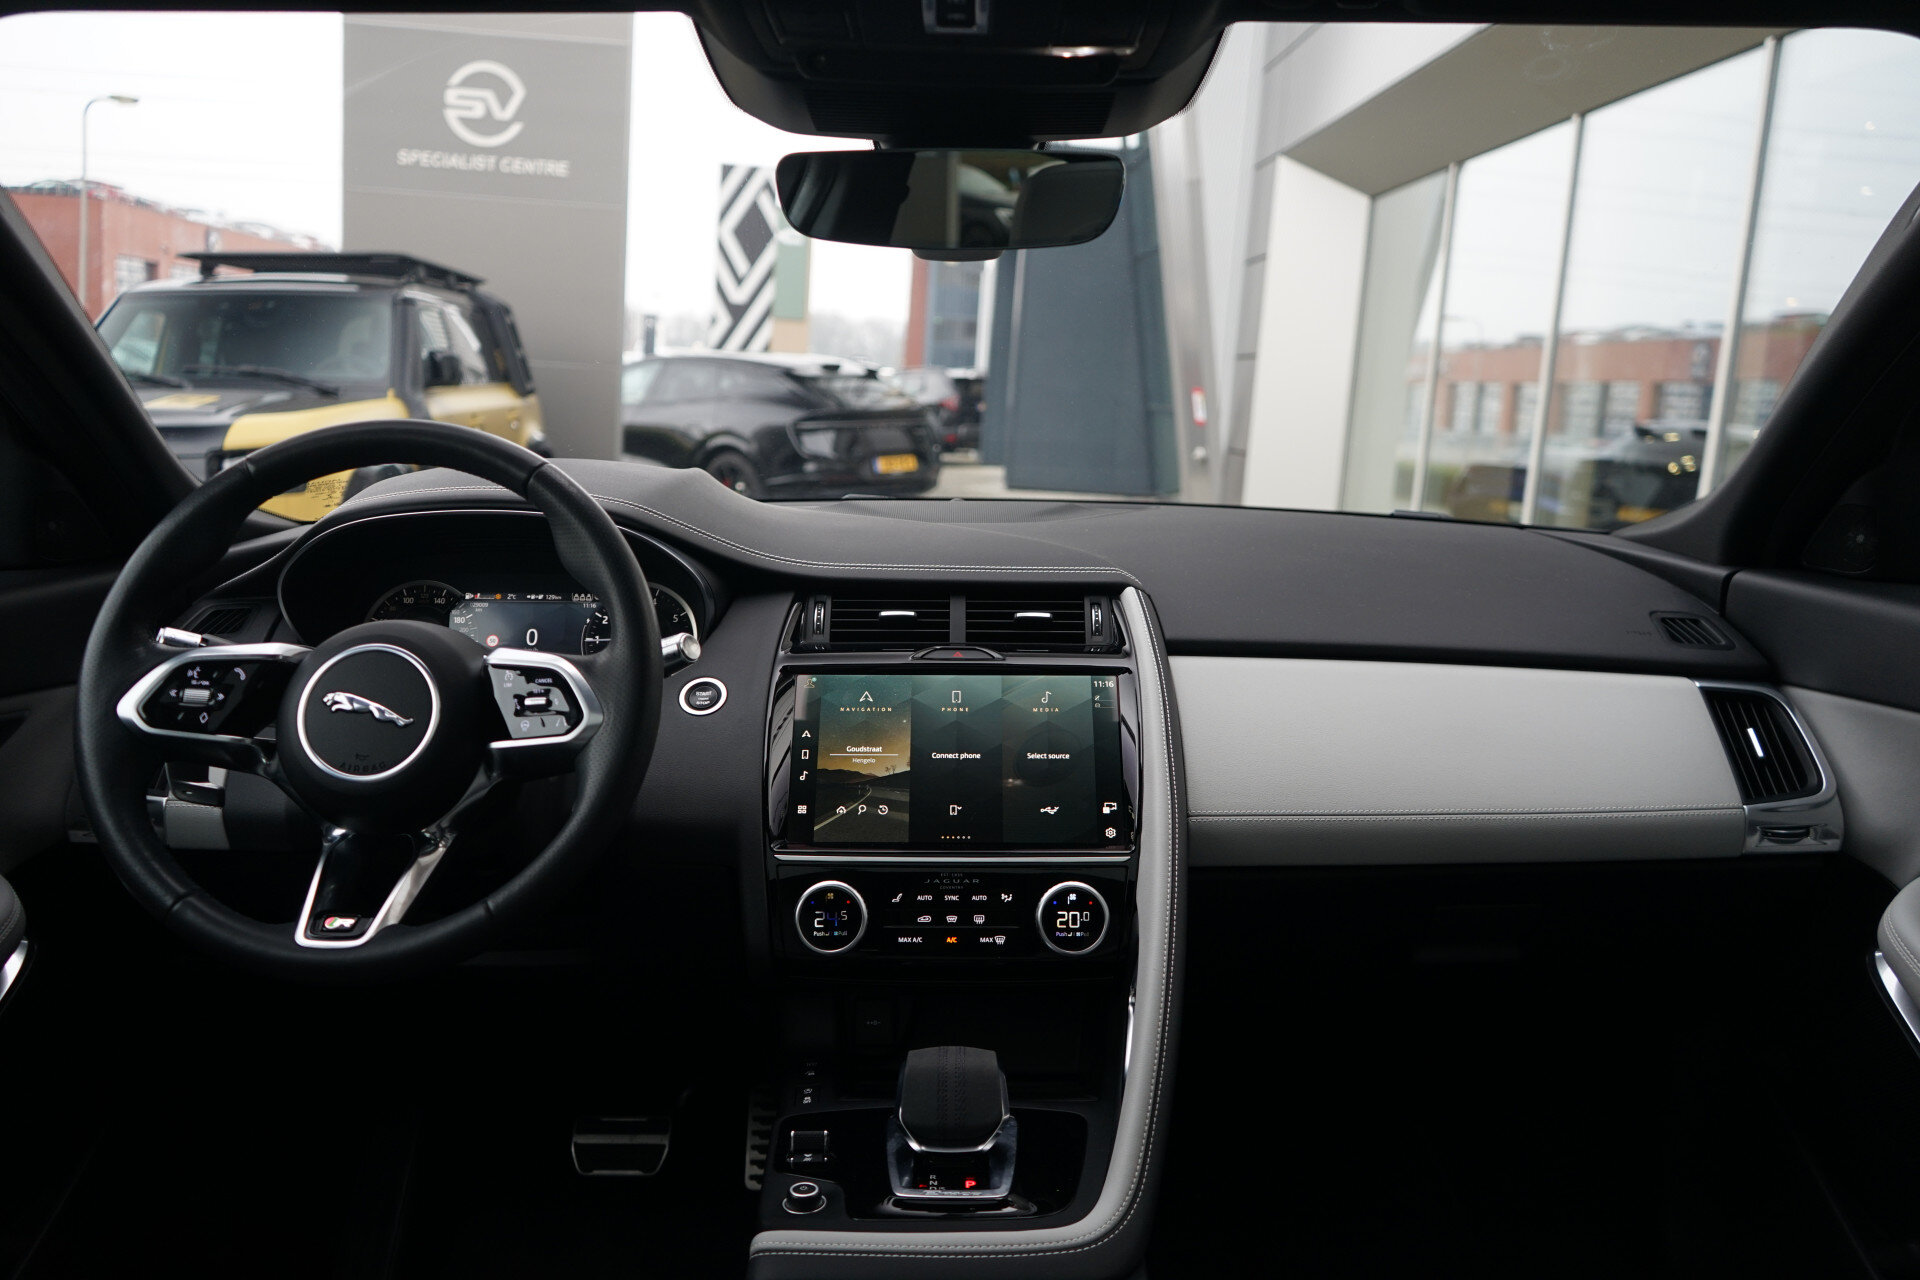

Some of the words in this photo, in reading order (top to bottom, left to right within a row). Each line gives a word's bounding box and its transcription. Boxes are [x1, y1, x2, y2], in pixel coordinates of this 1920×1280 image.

[396, 149, 496, 172] SPECIALIST
[500, 156, 570, 177] CENTRE
[602, 615, 609, 624] 2
[672, 614, 679, 623] 5
[526, 628, 539, 646] 0
[846, 745, 883, 753] Goudstraat
[960, 752, 981, 760] phone
[1056, 911, 1090, 928] 20.0
[965, 1180, 976, 1189] P
